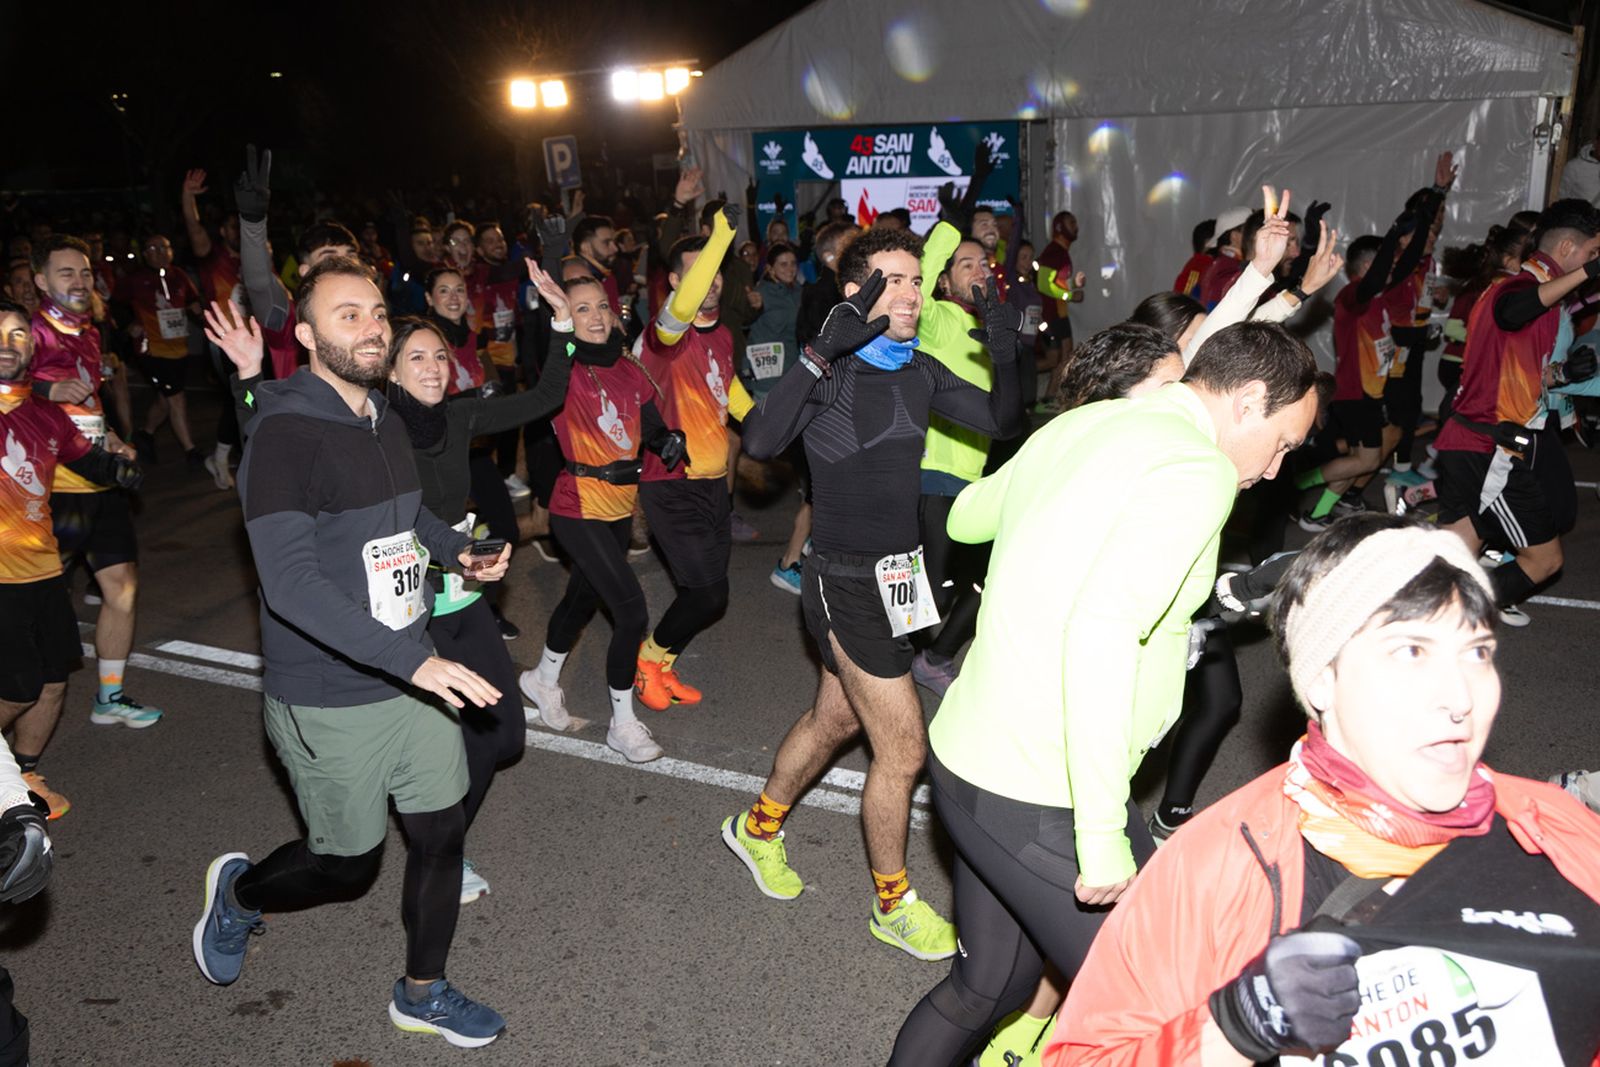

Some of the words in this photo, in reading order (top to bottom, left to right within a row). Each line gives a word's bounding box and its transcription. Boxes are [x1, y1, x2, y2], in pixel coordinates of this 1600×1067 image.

[850, 135, 874, 156] 43
[873, 133, 914, 154] SAN
[552, 144, 572, 173] P
[812, 158, 823, 171] 43
[846, 150, 910, 175] ANTÓN
[938, 154, 950, 168] 43
[908, 199, 937, 212] SAN
[755, 355, 778, 367] 5799
[609, 423, 623, 441] 43
[16, 466, 33, 485] 43
[382, 544, 404, 558] NOCHE
[406, 542, 414, 551] DE
[375, 560, 391, 572] SAN
[392, 563, 420, 596] 318
[883, 572, 896, 583] SAN
[1393, 968, 1420, 993] DE
